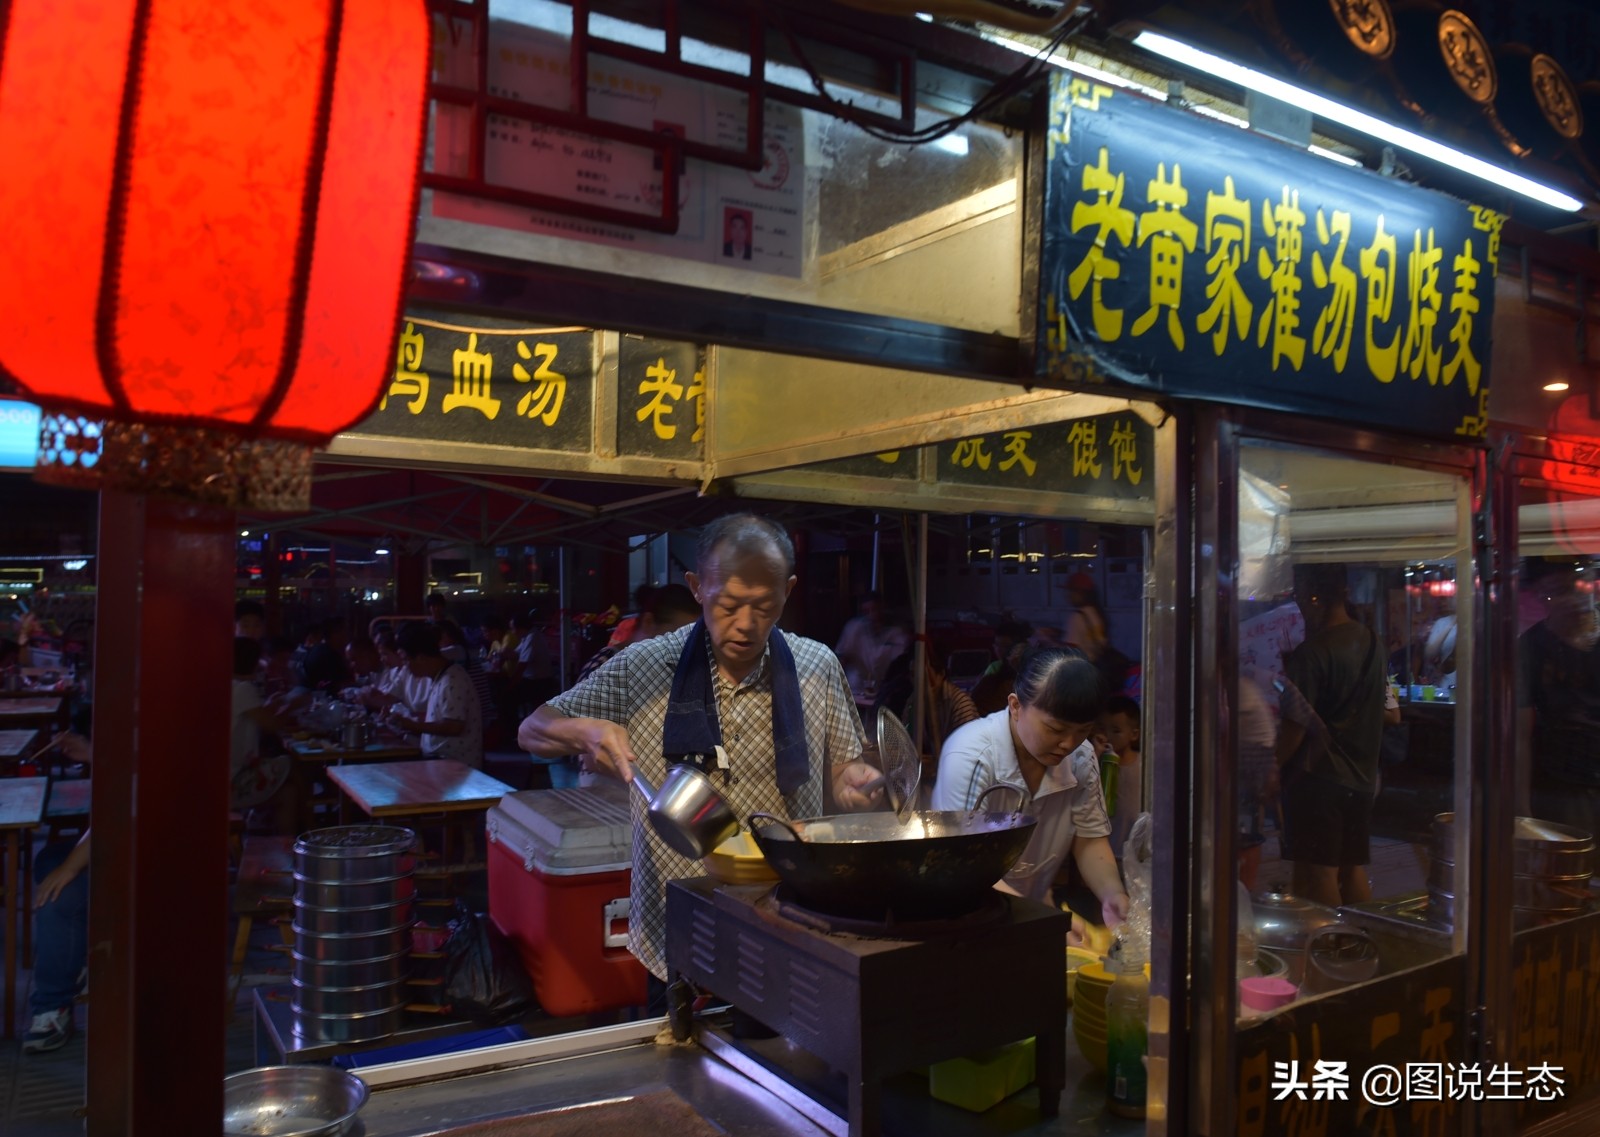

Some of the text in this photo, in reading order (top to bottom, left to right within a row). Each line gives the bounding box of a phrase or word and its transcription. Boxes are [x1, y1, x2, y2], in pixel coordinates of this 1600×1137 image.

[1068, 146, 1482, 396] 老黄家灌汤包烧麦
[1066, 419, 1143, 485] 馄饨
